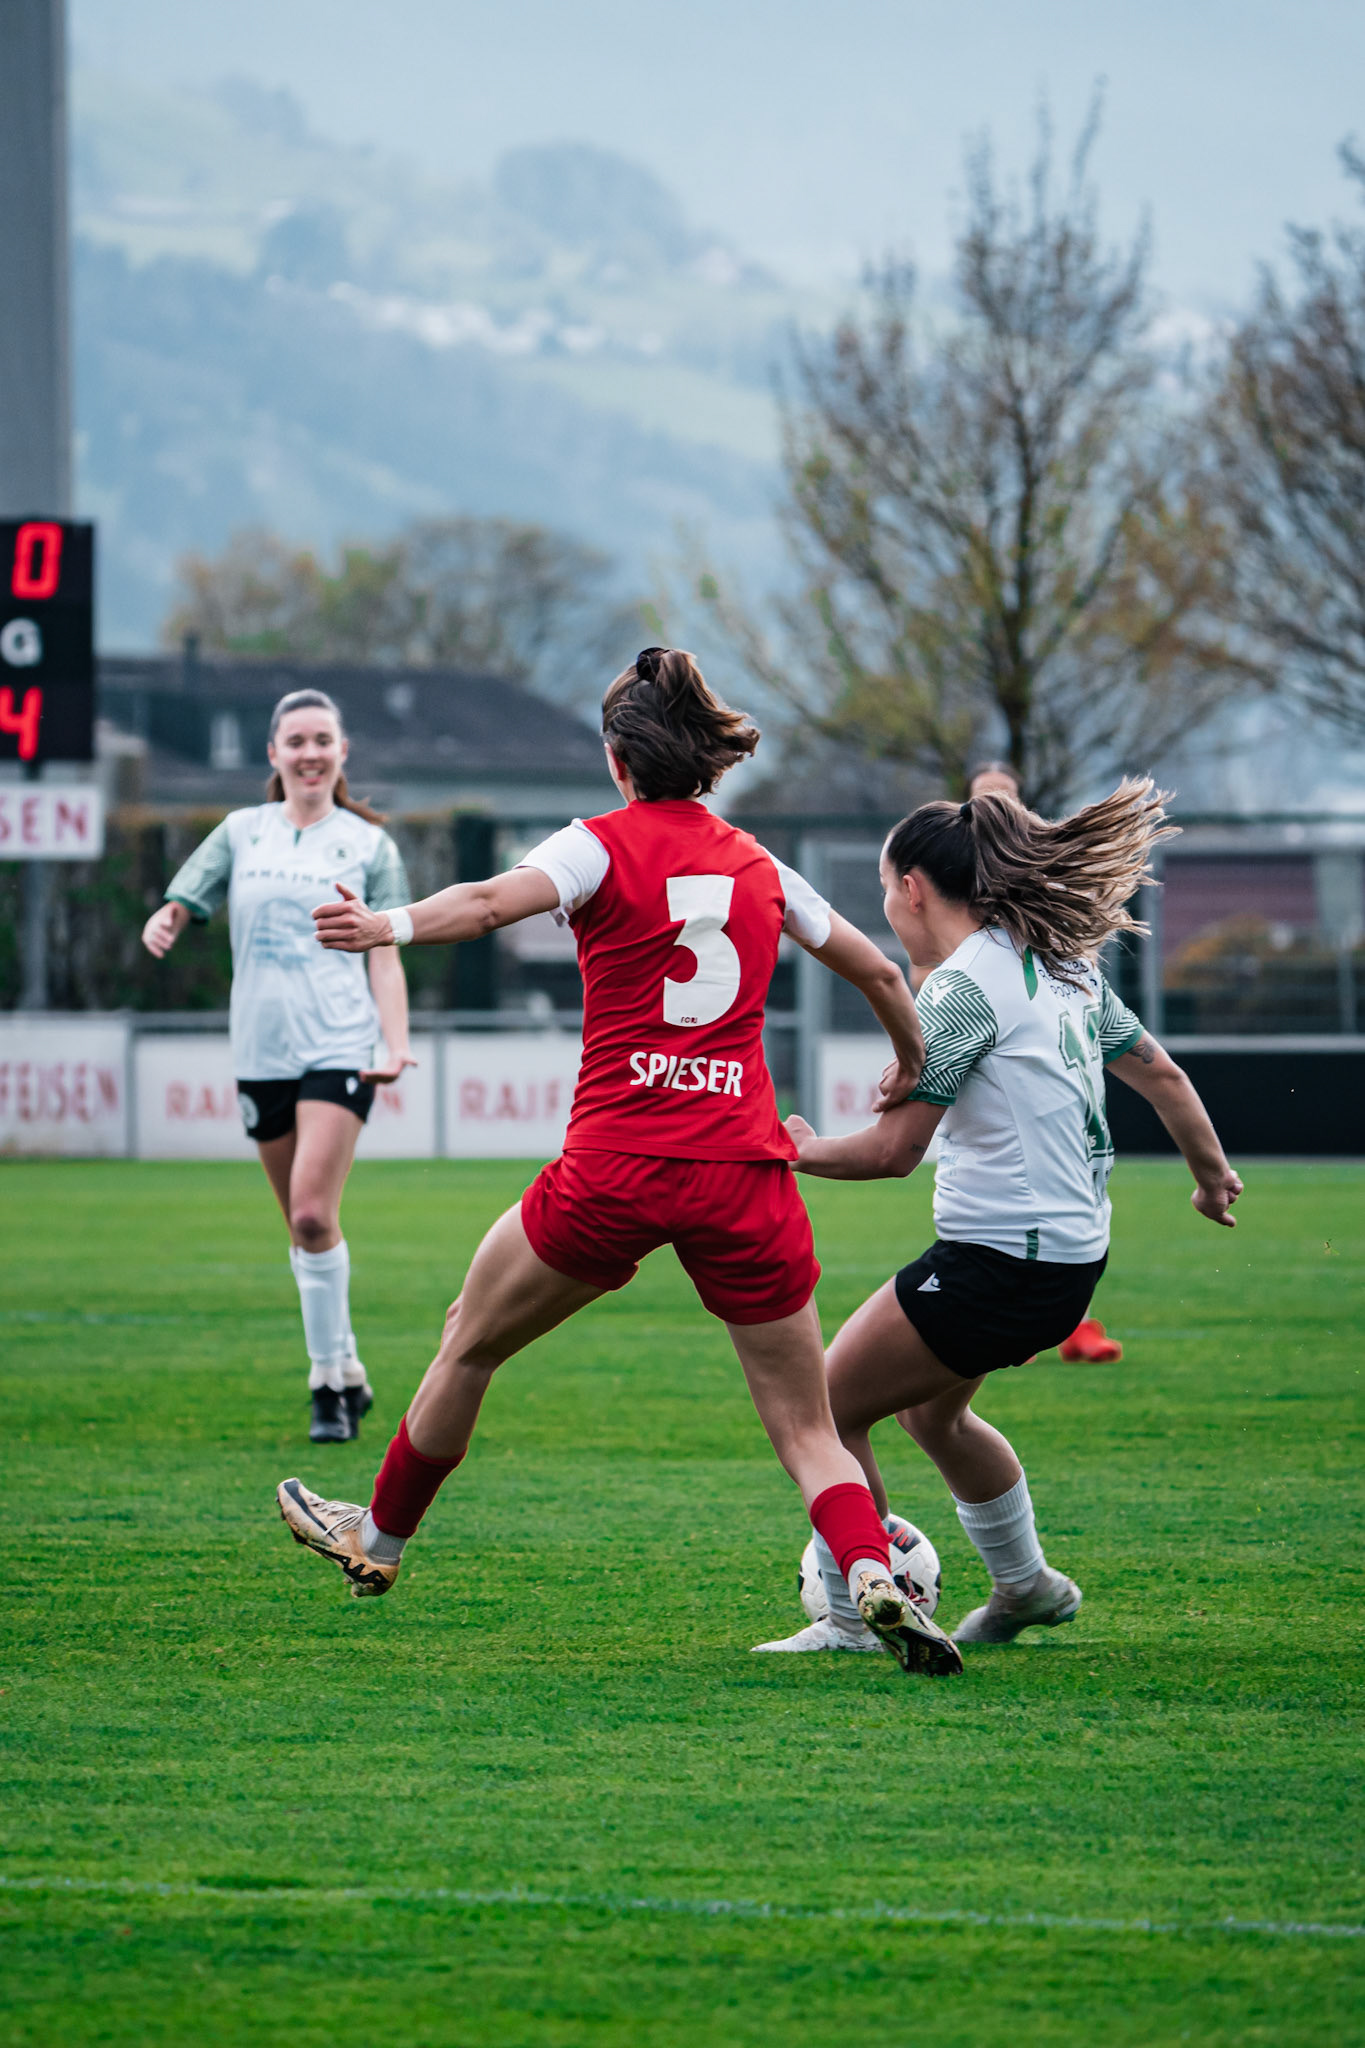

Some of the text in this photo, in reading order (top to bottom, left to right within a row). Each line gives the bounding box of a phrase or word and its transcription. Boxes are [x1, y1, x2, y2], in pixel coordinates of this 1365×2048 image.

[11, 522, 63, 599] 0
[0, 617, 42, 666] G
[663, 874, 741, 1027] 3
[629, 1051, 743, 1097] SPIESER
[460, 1080, 562, 1119] RAIF
